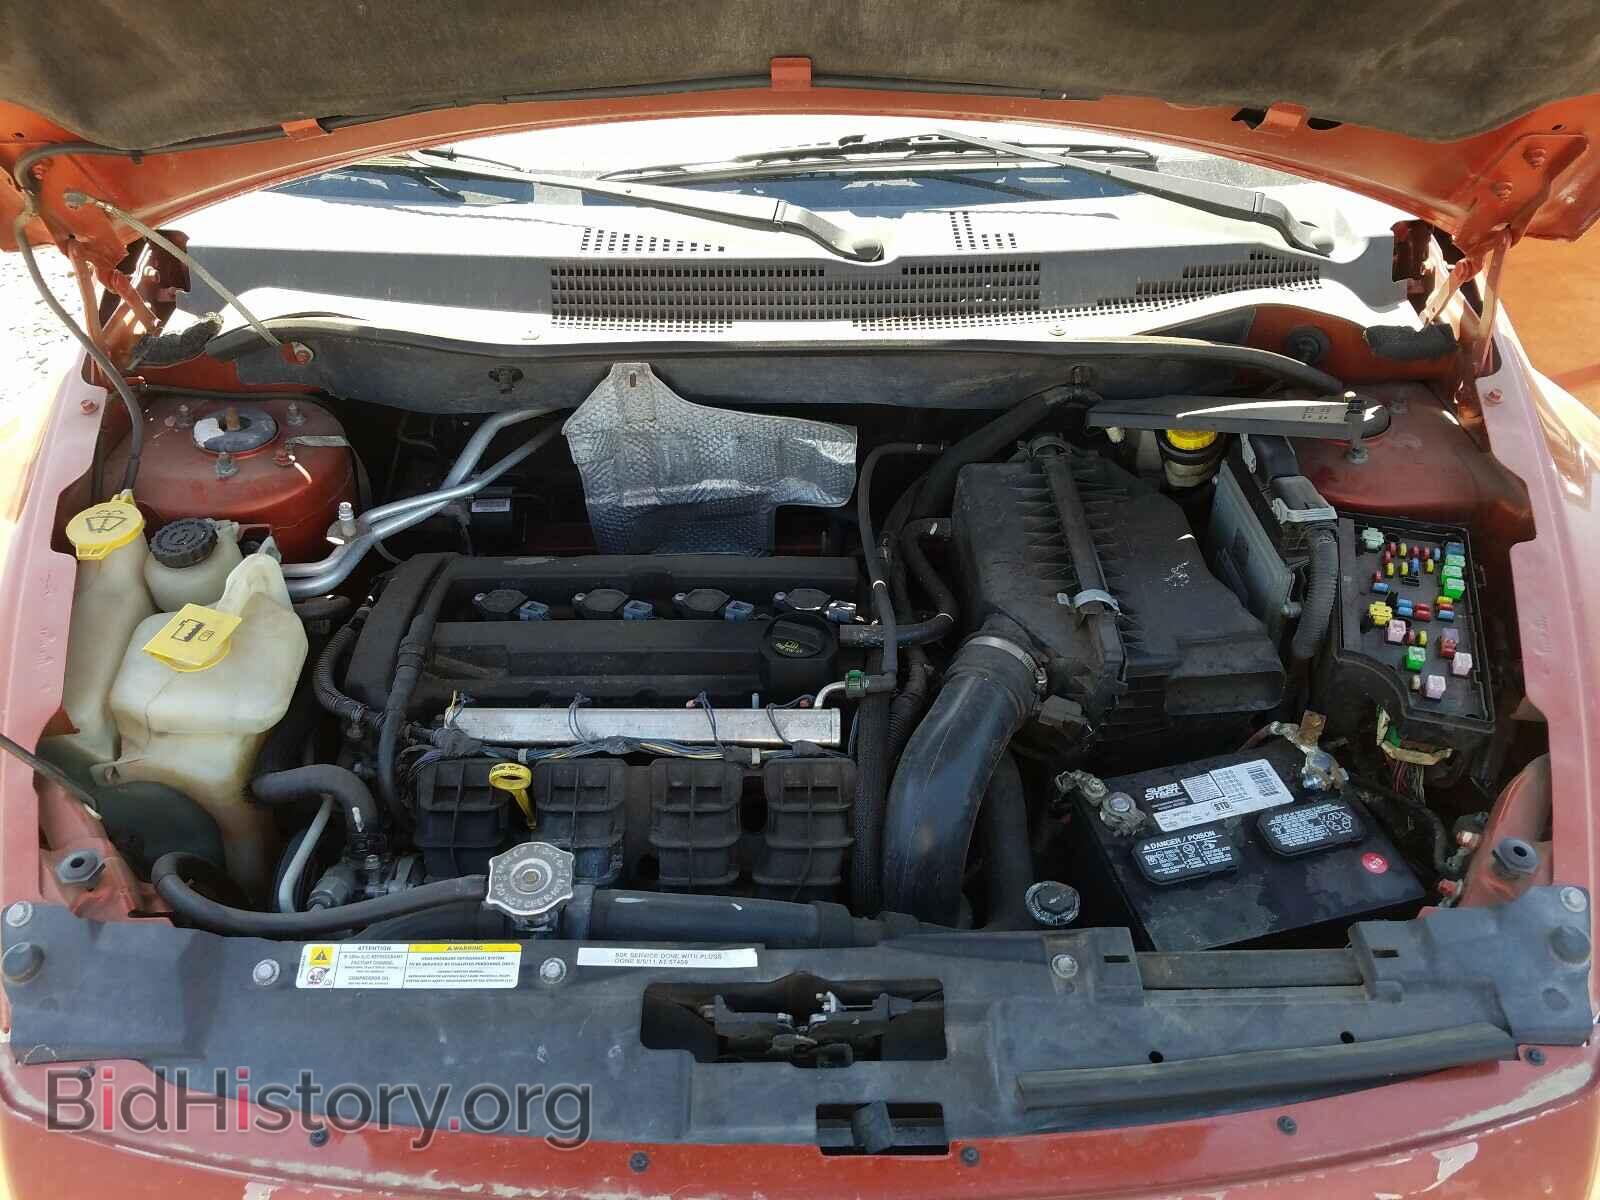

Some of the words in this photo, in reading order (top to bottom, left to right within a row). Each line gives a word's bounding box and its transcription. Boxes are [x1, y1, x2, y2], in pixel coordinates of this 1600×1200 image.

[1144, 788, 1180, 801] START
[1146, 782, 1180, 794] SUPER
[1150, 837, 1181, 849] DANGER
[1187, 831, 1216, 842] POISON
